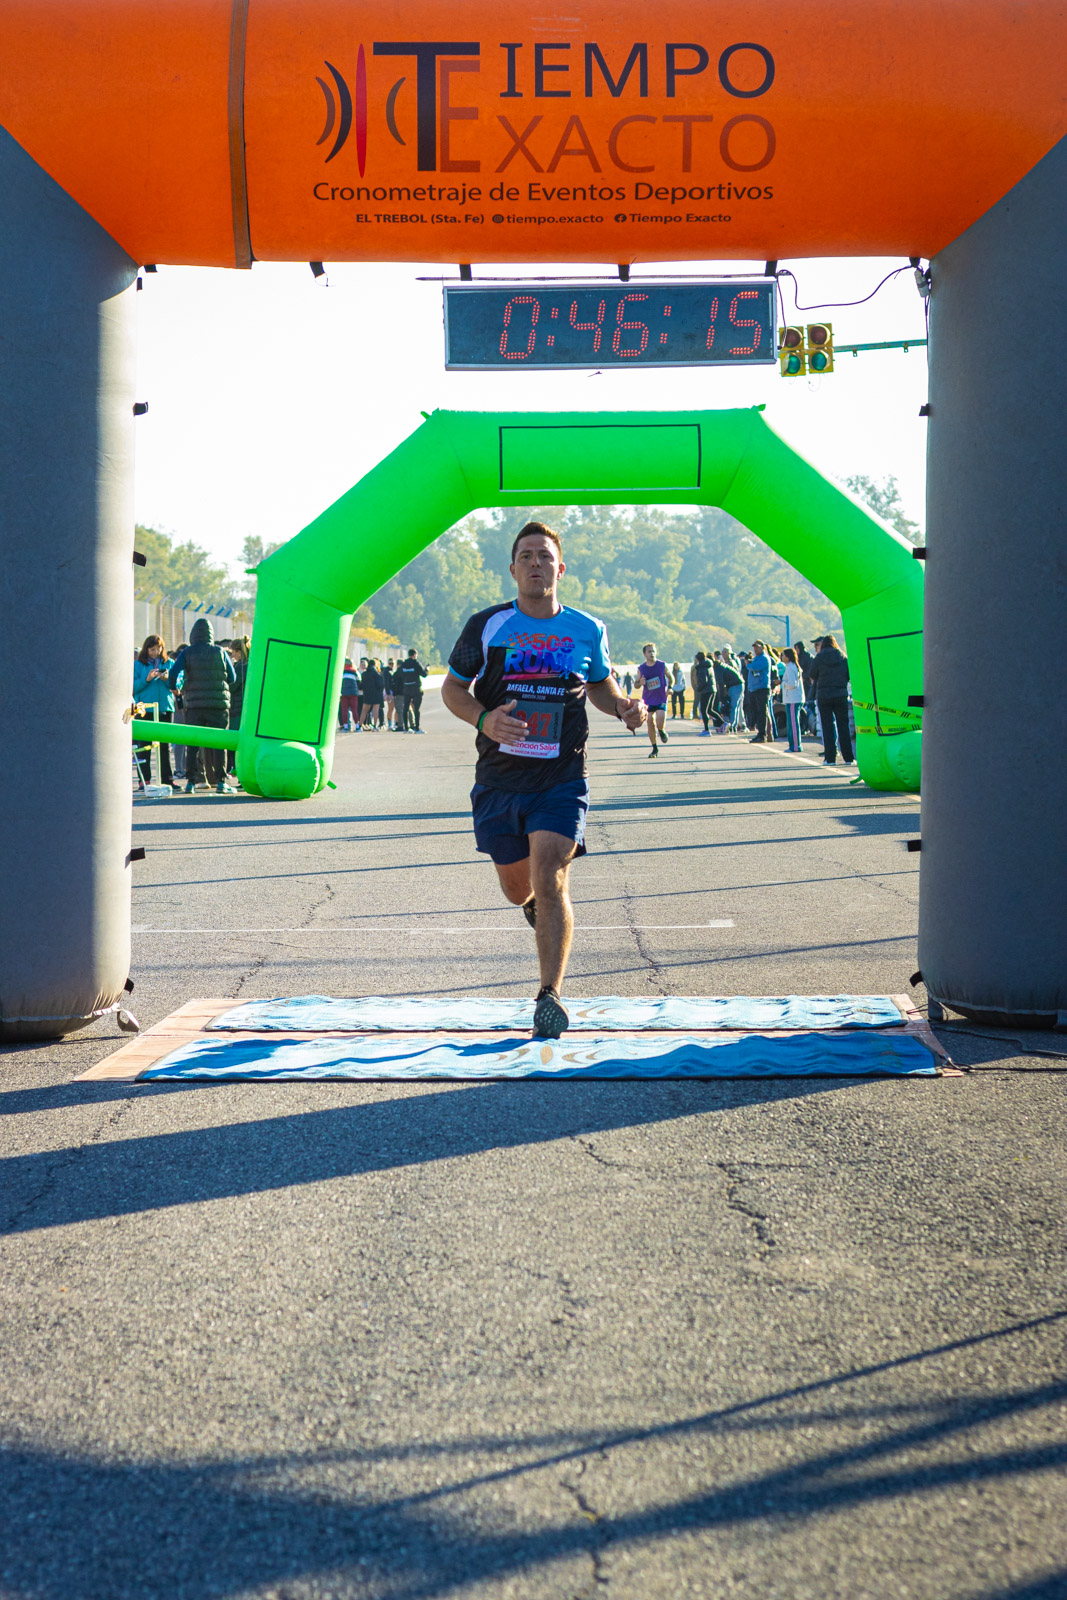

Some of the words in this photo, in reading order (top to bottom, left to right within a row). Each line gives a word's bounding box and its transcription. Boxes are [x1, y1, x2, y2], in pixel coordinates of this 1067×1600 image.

[313, 182, 482, 206] Cronometraje
[489, 182, 520, 201] de
[528, 182, 626, 201] Eventos
[634, 182, 774, 204] Deportivos
[356, 214, 373, 223] EL
[374, 214, 428, 224] TREBOL
[431, 213, 462, 225] (Sta.
[464, 213, 485, 225] Fe)
[629, 213, 682, 224] Tiempo
[686, 213, 732, 223] Exacto
[506, 683, 535, 693] RAFAELA,
[536, 685, 557, 695] SANTA
[557, 687, 565, 696] FE
